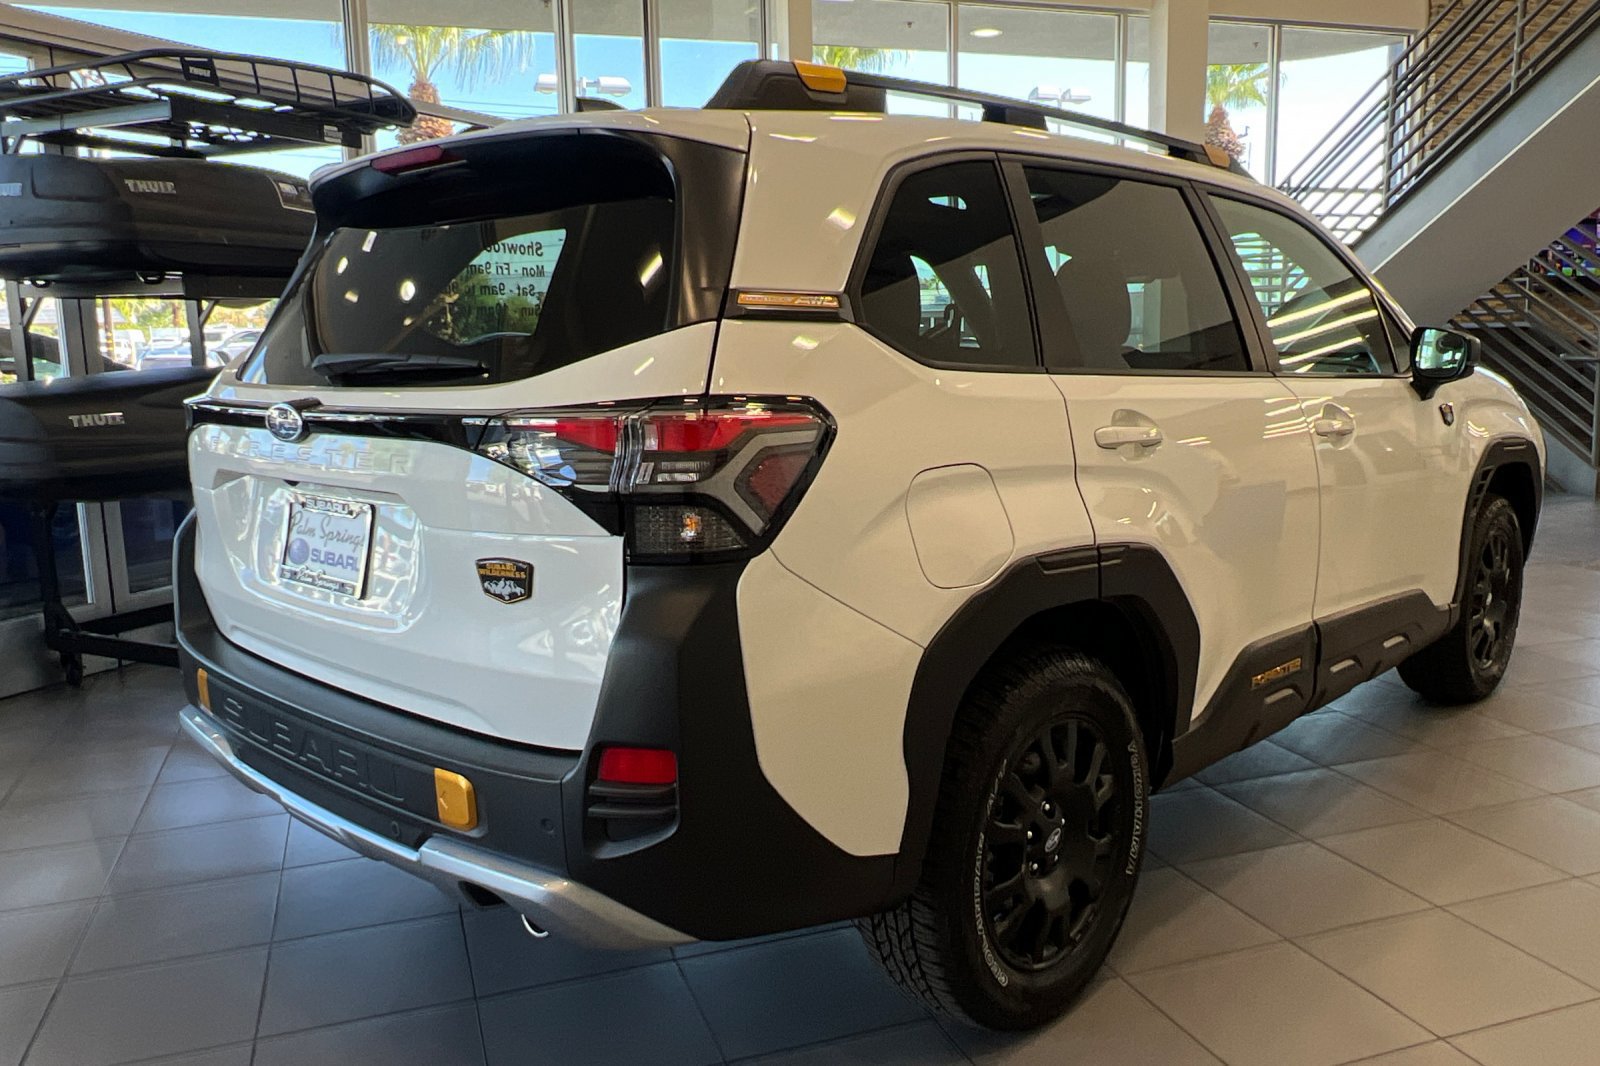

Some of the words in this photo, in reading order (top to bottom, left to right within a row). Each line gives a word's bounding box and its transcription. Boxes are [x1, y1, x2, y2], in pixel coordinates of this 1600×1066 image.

[124, 179, 177, 194] THULE
[68, 412, 126, 428] THULE
[305, 497, 350, 514] SUBARU
[291, 510, 316, 538] Palm
